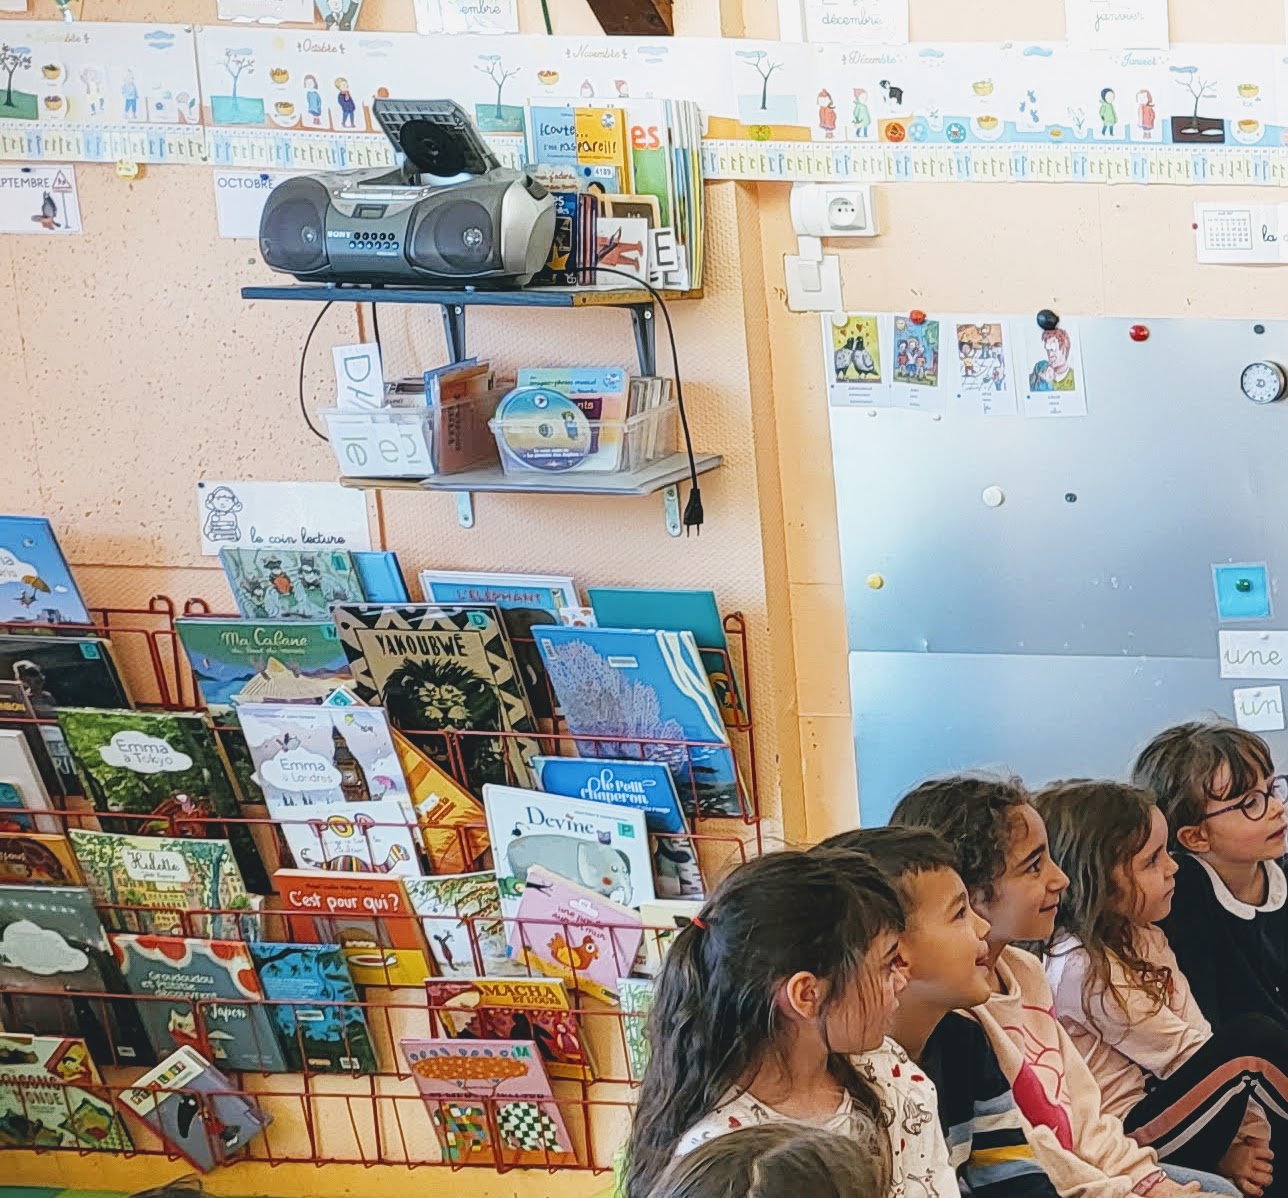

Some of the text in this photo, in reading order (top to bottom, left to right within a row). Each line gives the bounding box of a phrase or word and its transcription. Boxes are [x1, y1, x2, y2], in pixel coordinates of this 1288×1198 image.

[822, 12, 883, 27] décembre
[572, 44, 621, 59] Novembre
[0, 177, 50, 188] PTEMBRE
[217, 177, 275, 190] OCTOBRE
[327, 230, 351, 239] SONY
[1261, 225, 1278, 242] la
[654, 230, 675, 266] E
[251, 526, 346, 545] le coin lecture
[221, 626, 310, 649] Ma Cabane
[1224, 647, 1283, 667] une
[1240, 696, 1282, 717] un
[115, 738, 169, 754] Emma
[133, 753, 174, 768] Tokyo
[279, 758, 326, 772] Emma
[525, 805, 596, 835] Devine
[289, 890, 321, 908] C'est
[327, 895, 358, 913] pour
[481, 984, 556, 999] MACHA
